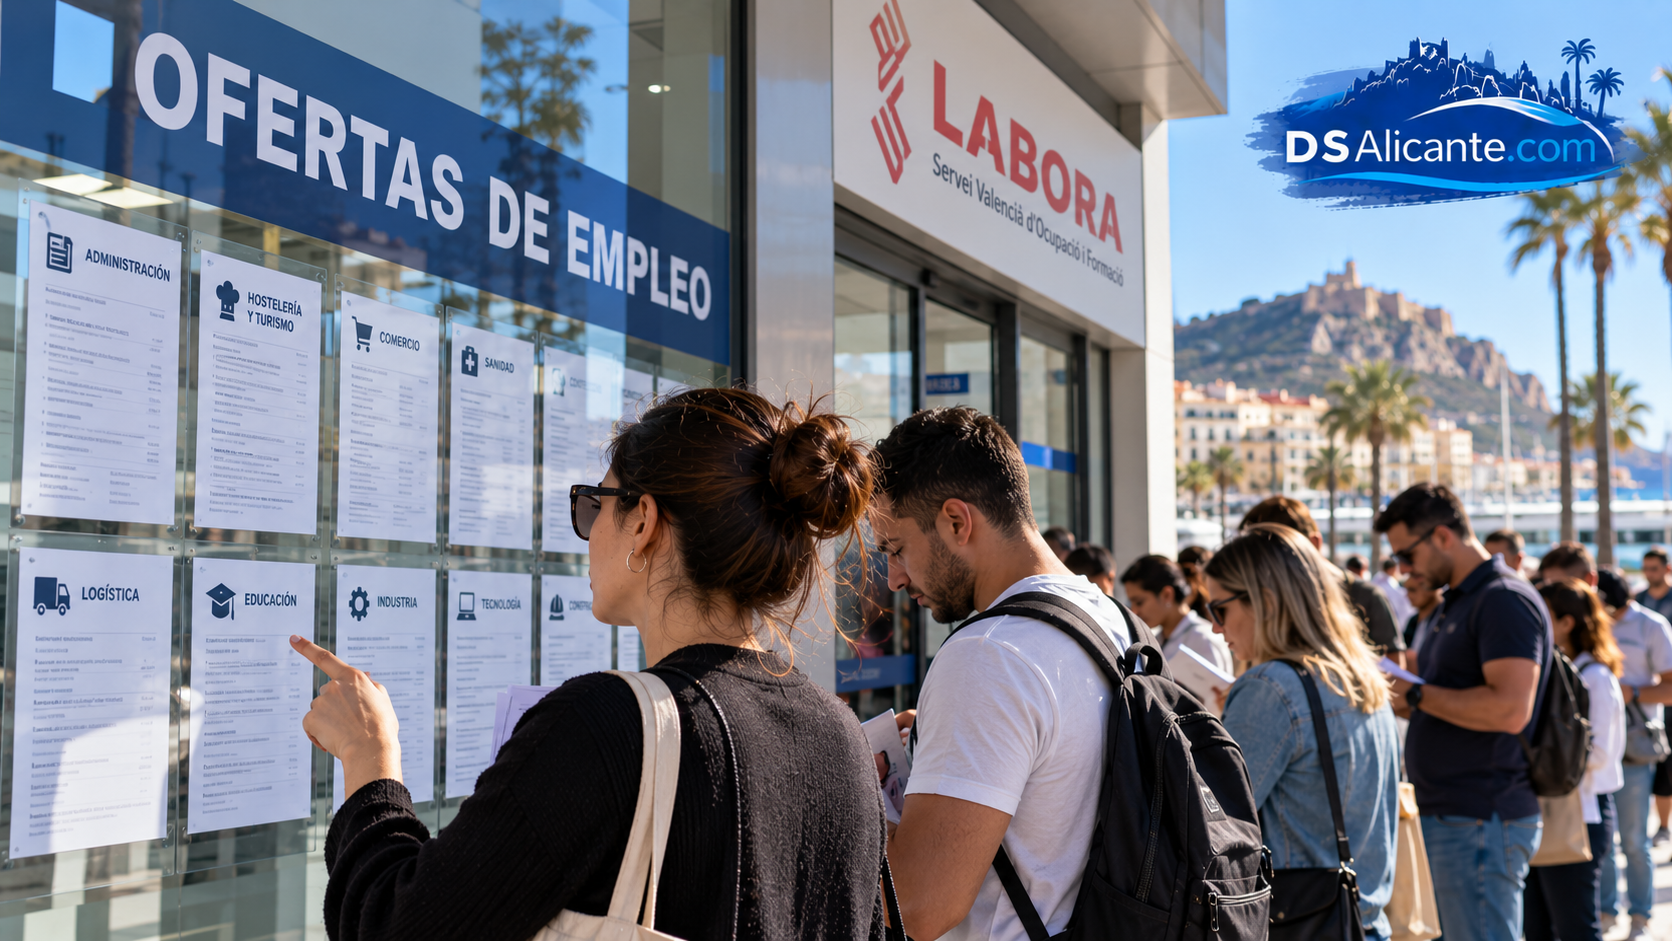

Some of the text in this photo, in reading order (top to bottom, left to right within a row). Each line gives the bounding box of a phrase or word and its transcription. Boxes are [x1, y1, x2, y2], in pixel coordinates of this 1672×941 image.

[934, 59, 1123, 254] LABORA
[135, 32, 711, 321] OFERTAS DE EMPLEO
[932, 153, 973, 197] Servei
[976, 178, 1024, 228] Valencià
[1027, 212, 1081, 261] d'Ocupació
[1087, 248, 1124, 287] Formació
[85, 248, 171, 282] ADMINISTRACIÓN
[247, 291, 303, 317] HOSTELERÍA
[247, 310, 295, 333] Y TURISMO
[379, 331, 420, 352] COMERCIO
[484, 357, 515, 374] SANIDAD
[81, 583, 140, 602] LOGÍSTICA
[244, 591, 298, 607] EDUCACIÓN
[377, 596, 418, 608] INDUSTRIA
[481, 595, 522, 611] TECNOLOGÍA
